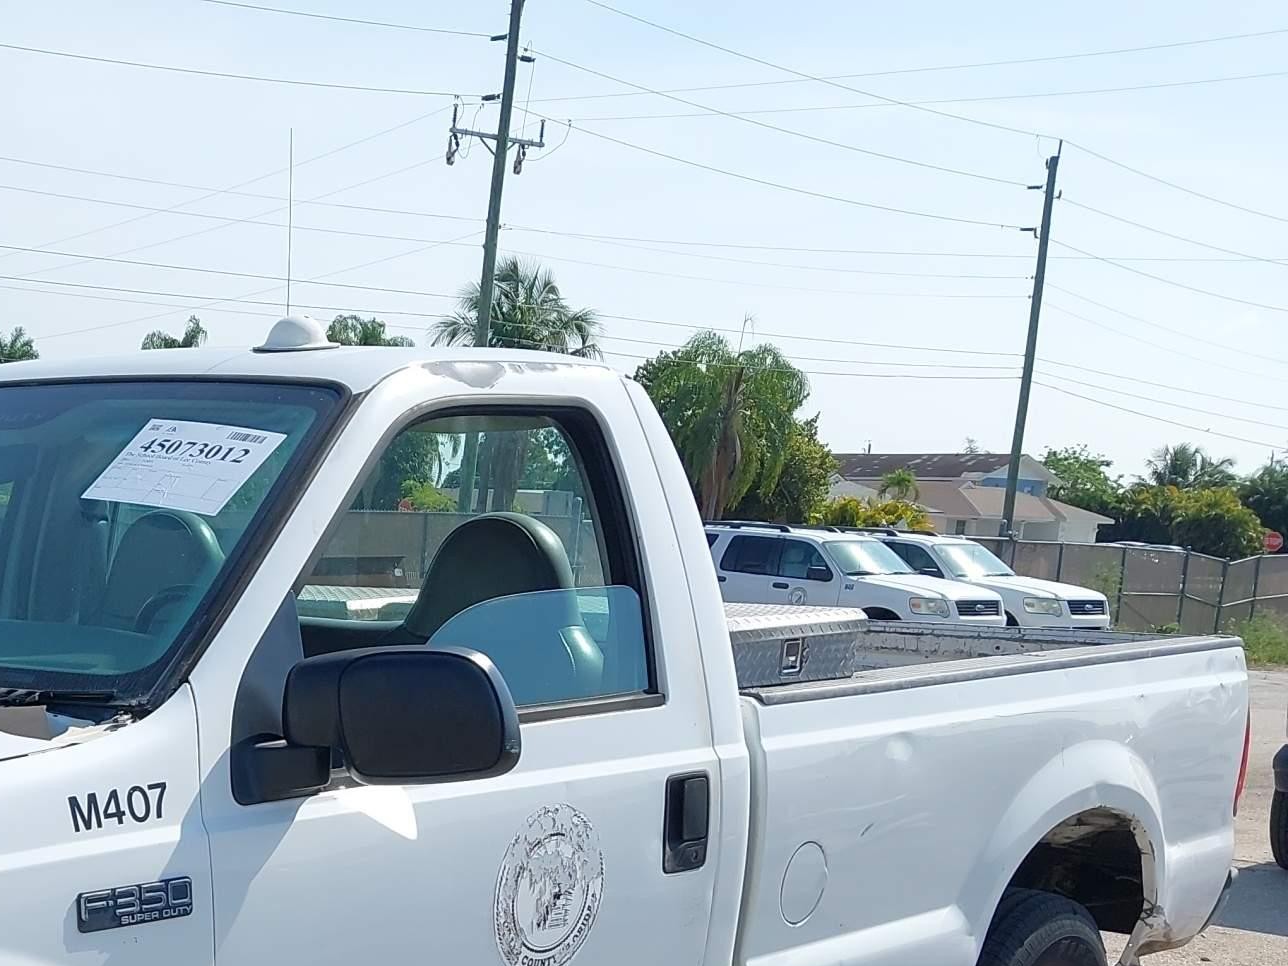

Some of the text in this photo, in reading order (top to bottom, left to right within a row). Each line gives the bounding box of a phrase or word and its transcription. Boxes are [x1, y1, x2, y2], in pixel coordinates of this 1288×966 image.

[140, 437, 251, 464] 45073012
[68, 781, 168, 833] M407
[120, 904, 192, 925] SUPER DUTY
